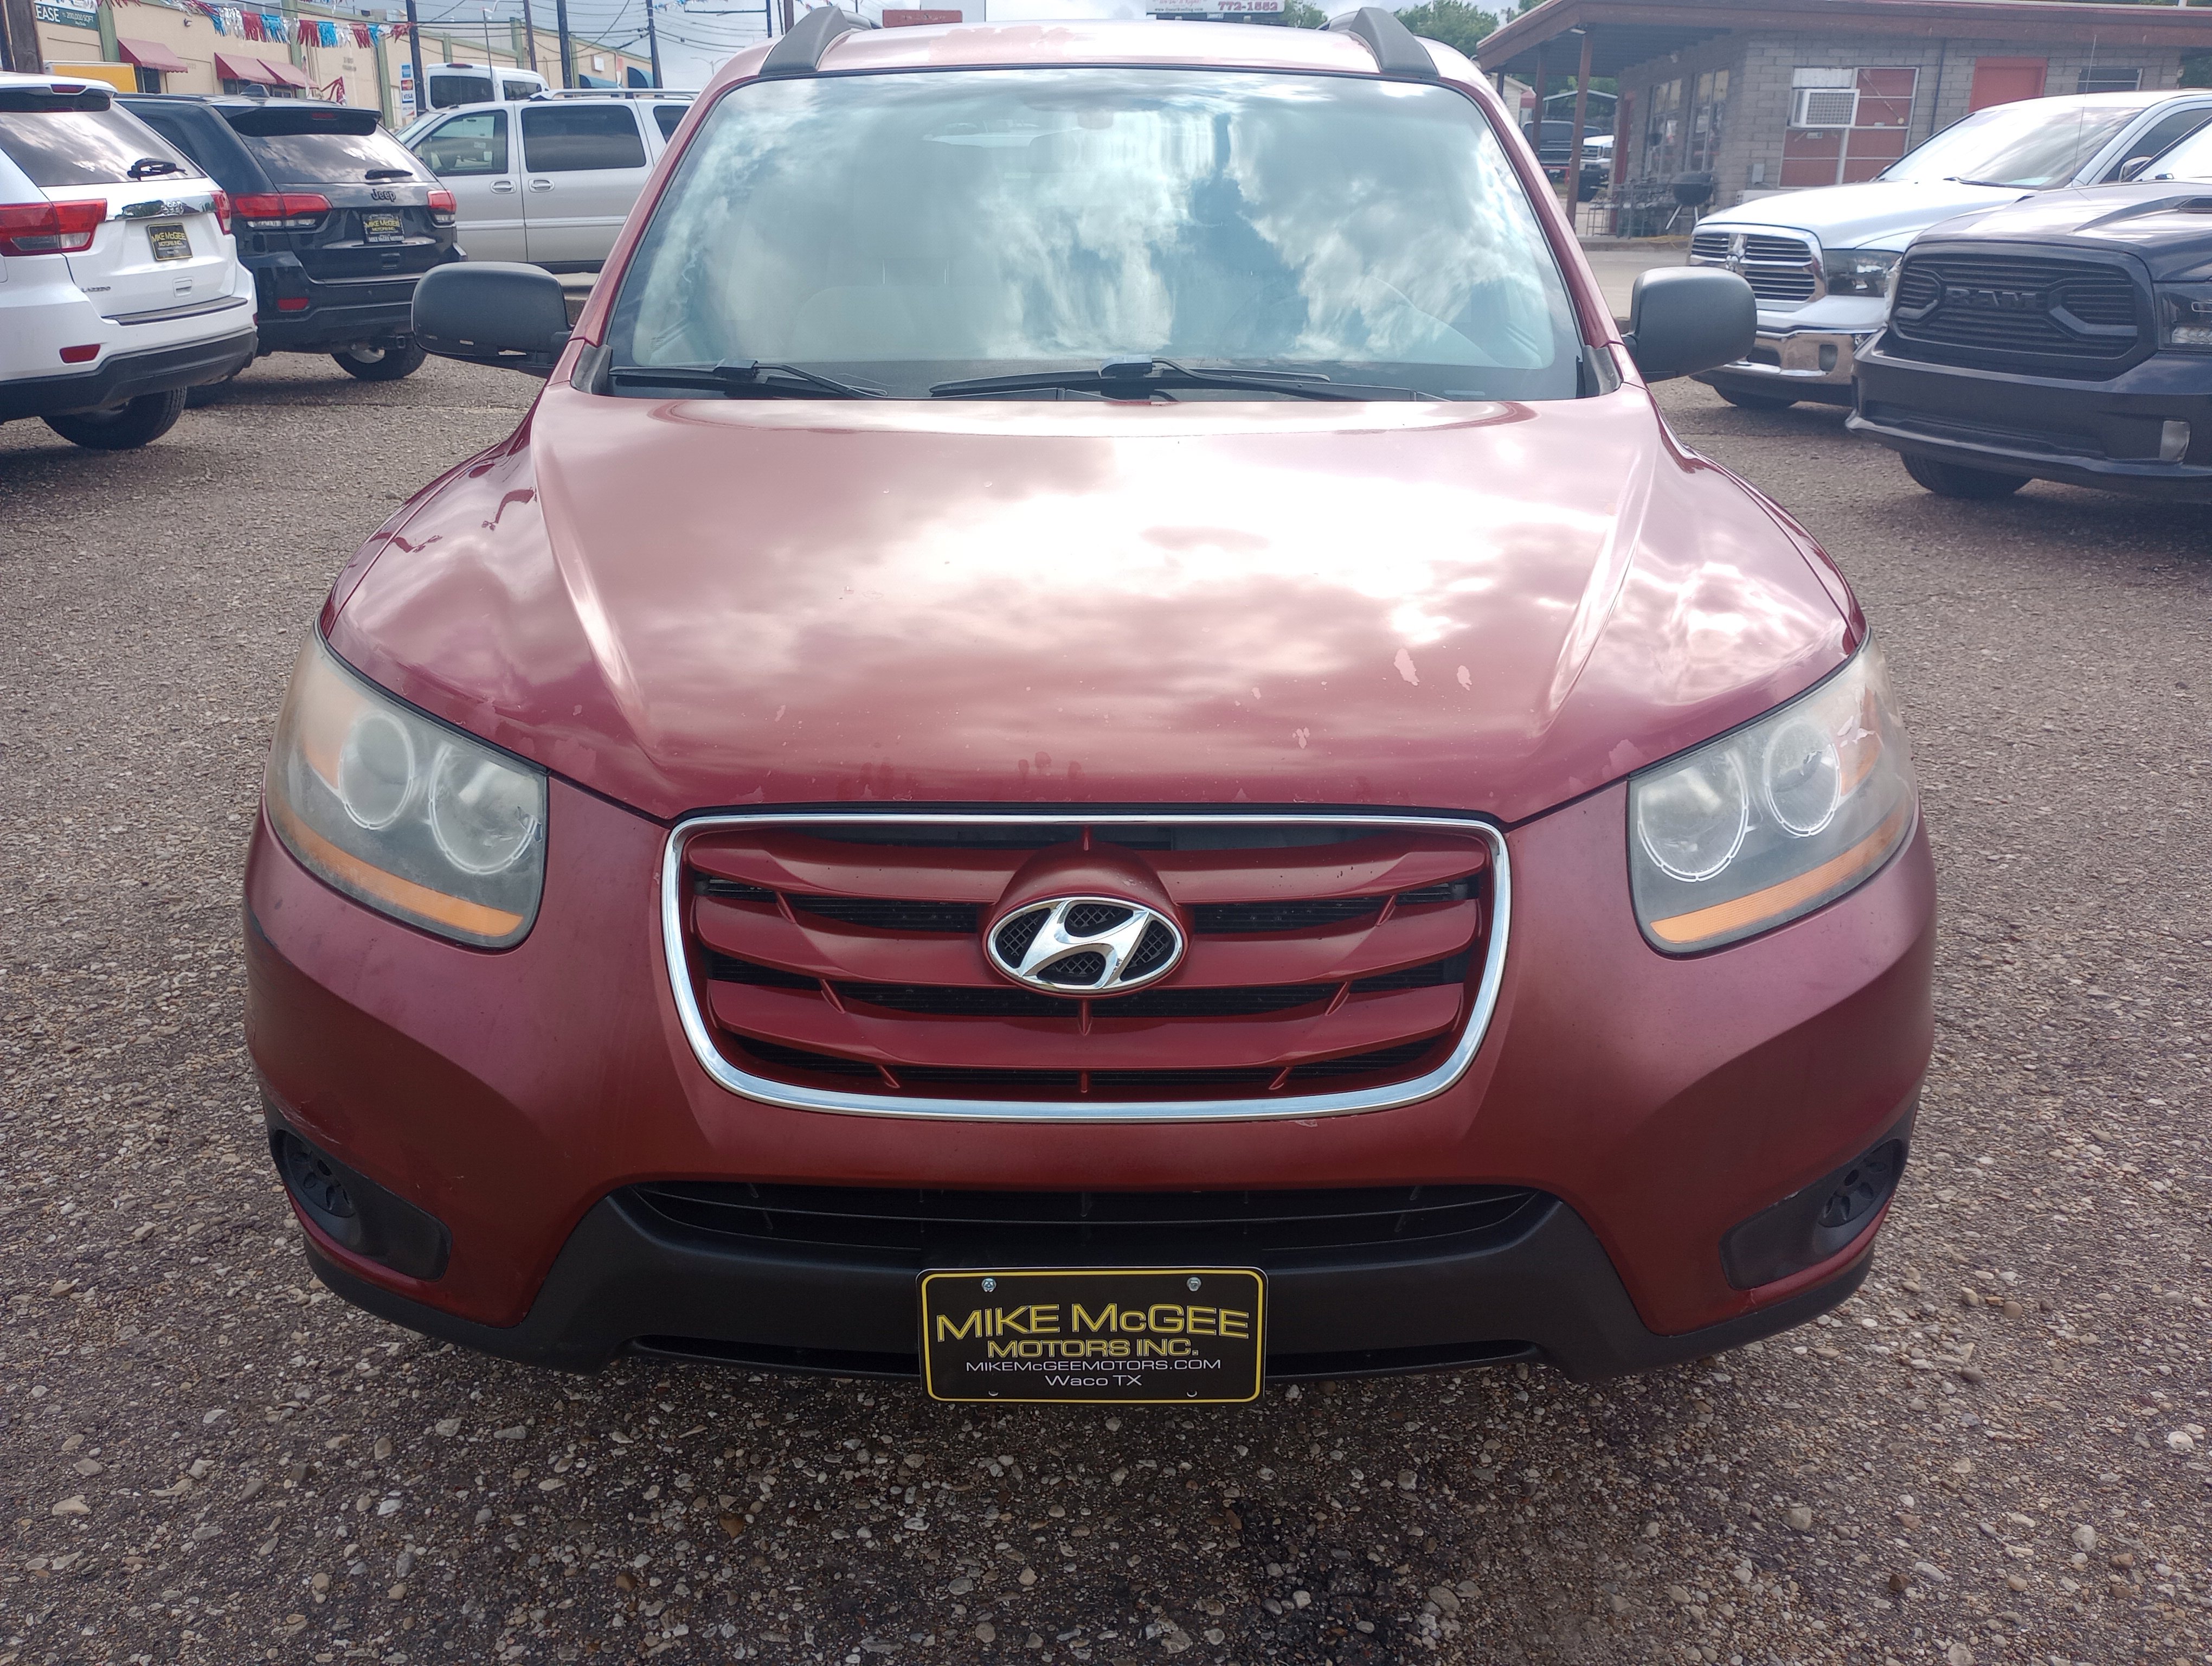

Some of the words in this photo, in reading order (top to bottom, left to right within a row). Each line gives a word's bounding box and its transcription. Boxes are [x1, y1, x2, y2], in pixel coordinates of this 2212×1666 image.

[35, 4, 61, 23] EASE
[371, 189, 396, 203] Jeep
[152, 232, 165, 243] MIKE
[1945, 287, 2037, 311] RAM
[936, 1304, 1060, 1342] MIKE
[1071, 1303, 1249, 1340] McGEE
[987, 1339, 1130, 1359] MOTORS
[1136, 1338, 1199, 1357] INC.
[966, 1359, 1221, 1372] MIKEMcGEEMOTORS.COM
[1044, 1375, 1109, 1387] Waco
[1113, 1374, 1142, 1386] TX
